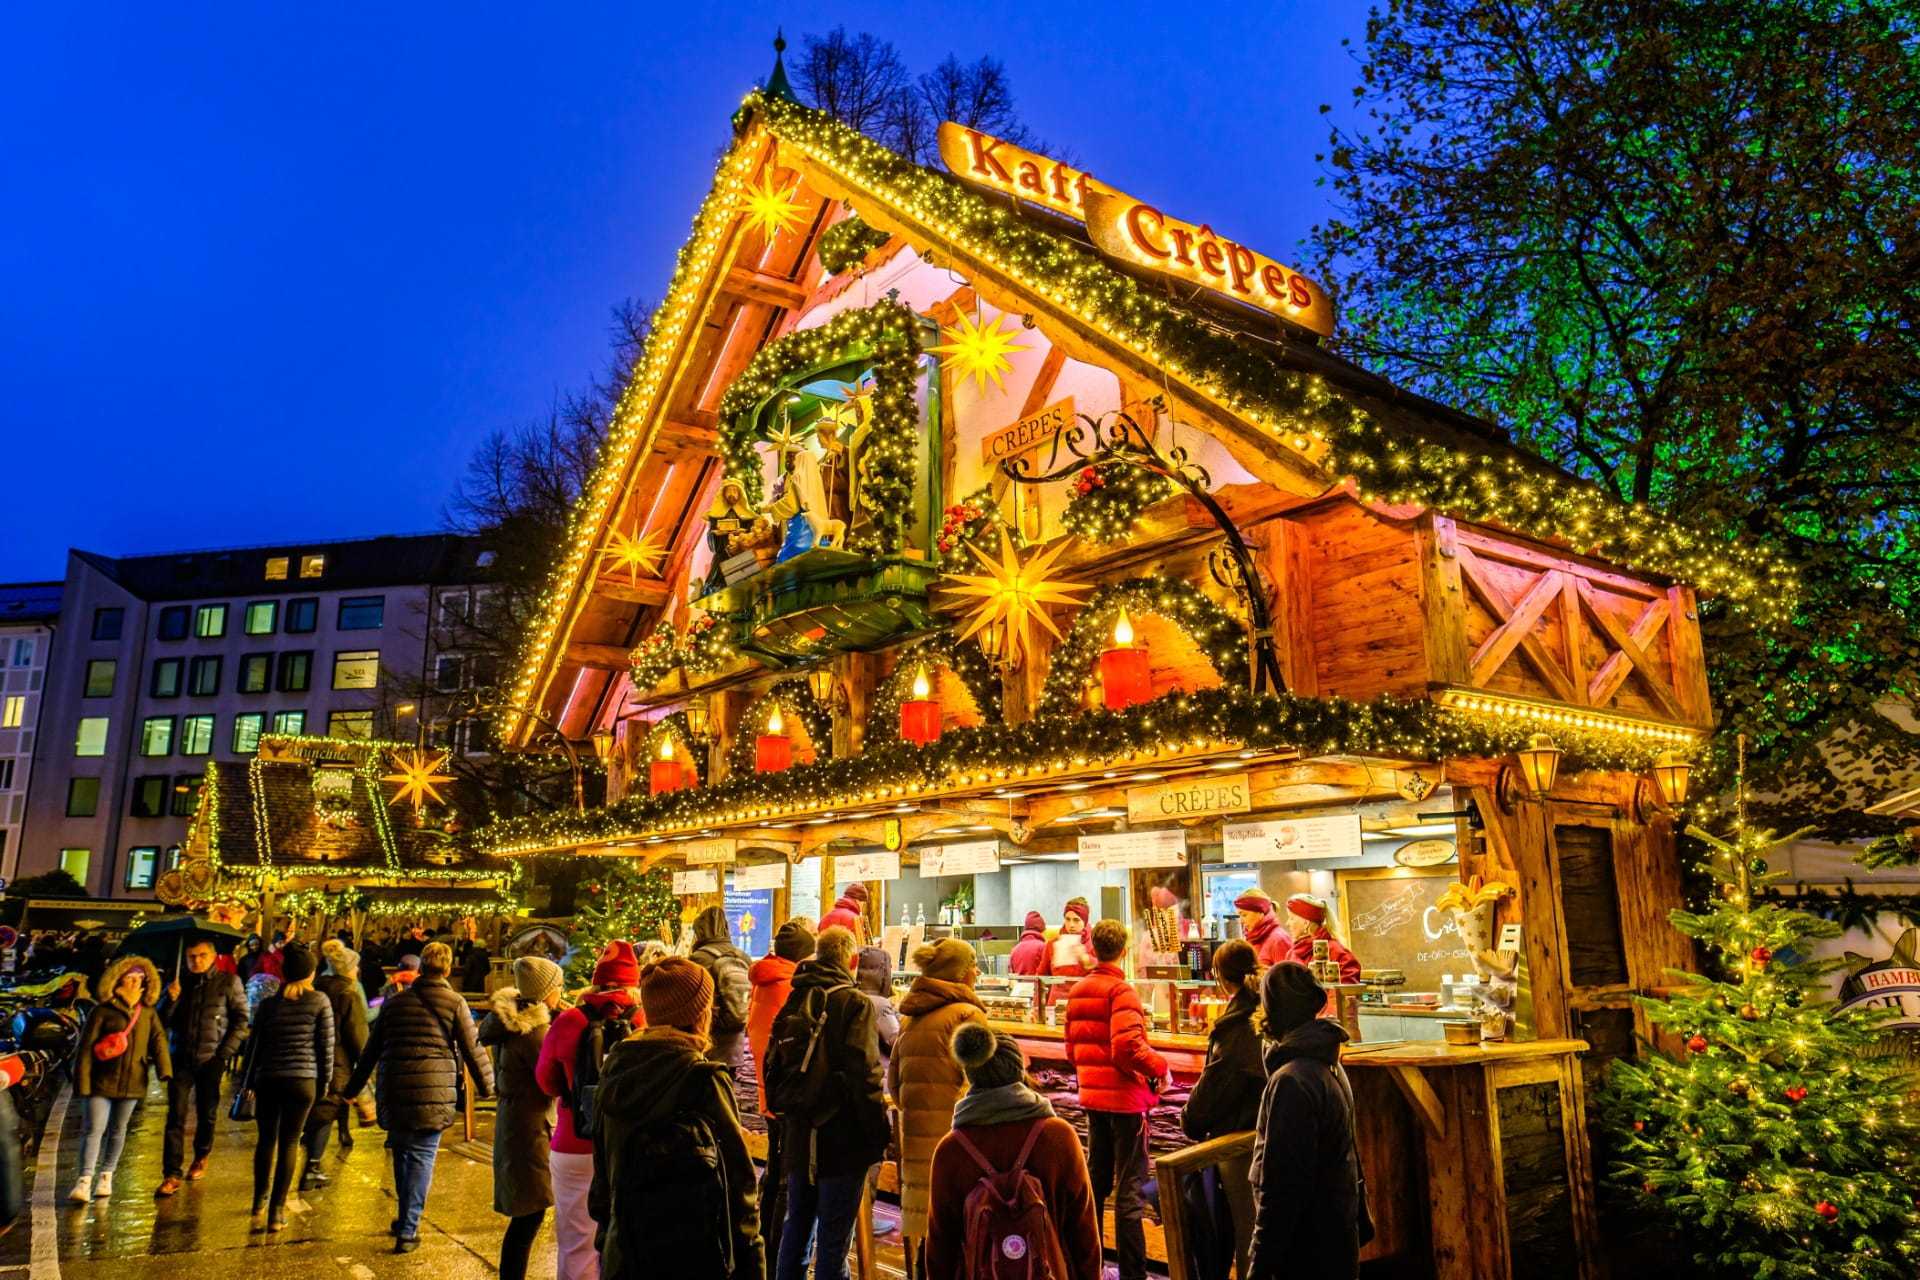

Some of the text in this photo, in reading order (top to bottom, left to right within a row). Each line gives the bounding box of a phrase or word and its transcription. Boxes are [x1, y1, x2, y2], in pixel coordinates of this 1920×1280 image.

[964, 129, 1112, 208] Kaff
[1126, 204, 1312, 309] Crêpes
[992, 408, 1063, 456] CRÊPES
[1160, 785, 1242, 814] CRÊPES
